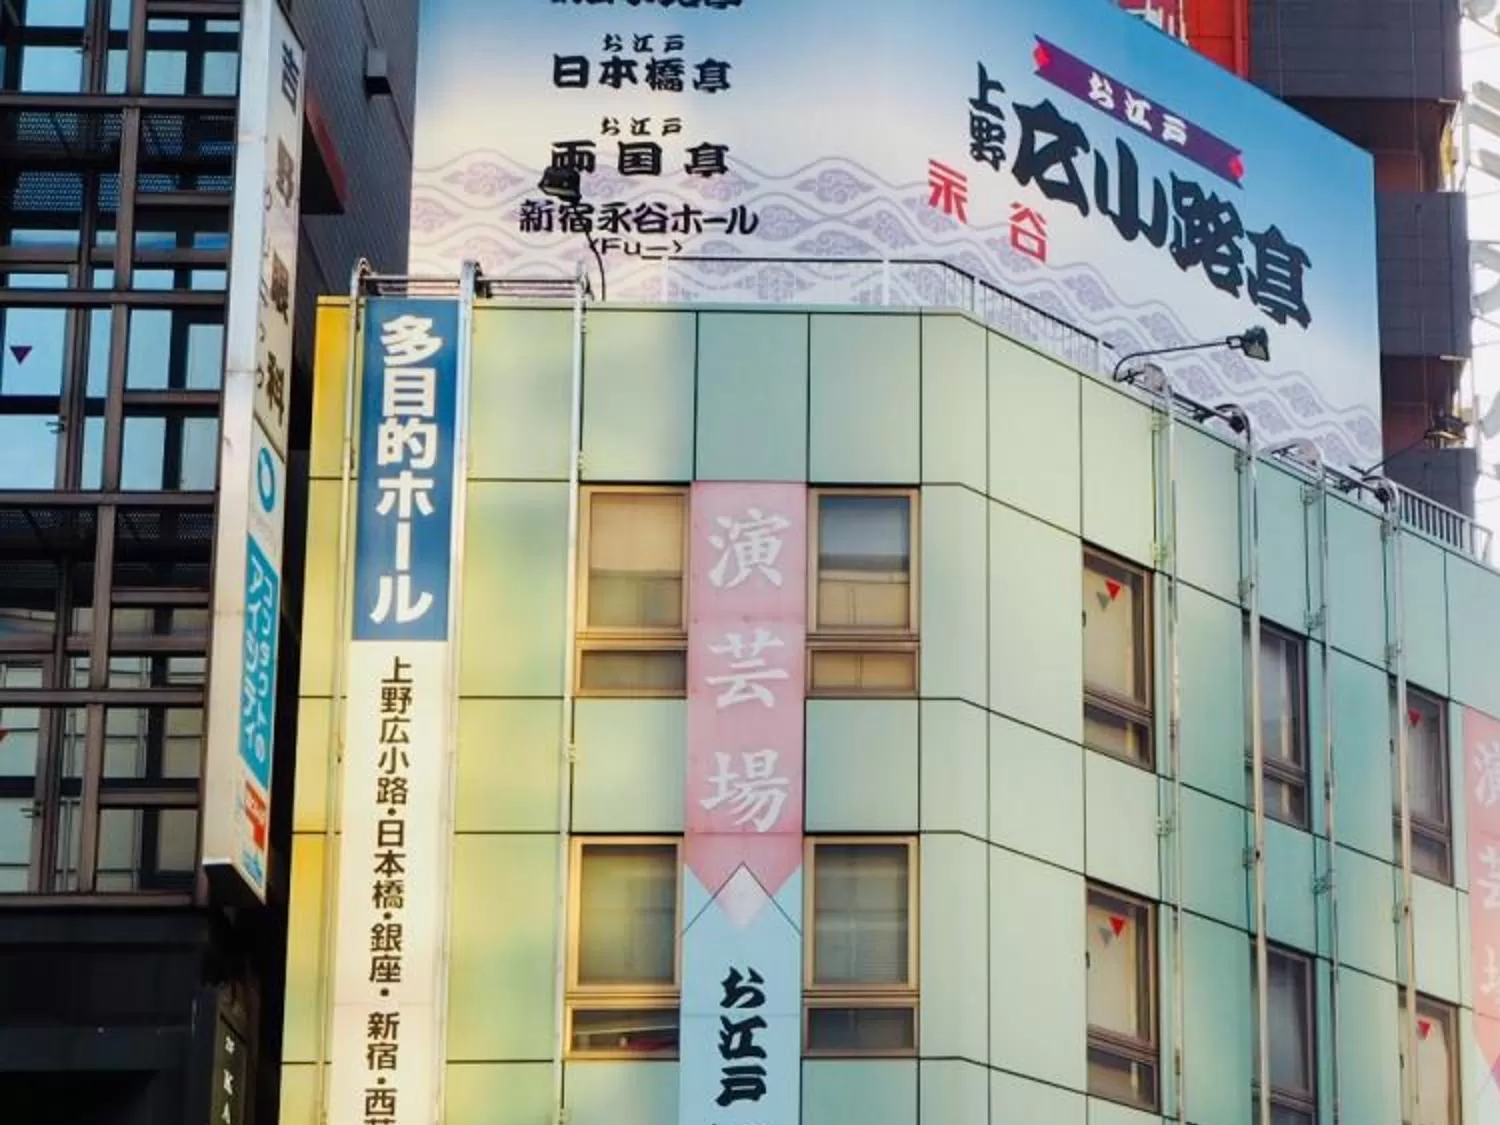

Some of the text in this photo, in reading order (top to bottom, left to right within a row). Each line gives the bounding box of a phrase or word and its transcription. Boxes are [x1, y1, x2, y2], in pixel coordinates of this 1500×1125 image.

[602, 33, 685, 53] お江戸
[552, 54, 732, 93] 日本橋亭
[600, 116, 683, 137] お江戸
[1088, 72, 1189, 146] お江戸
[550, 140, 731, 178] 両国亭
[518, 200, 760, 237] 新宿永谷ホール
[1012, 97, 1312, 330] 広小路亭
[370, 314, 444, 624] 多目的ホール
[698, 506, 794, 834] 演芸場
[714, 965, 768, 1108] お江戸
